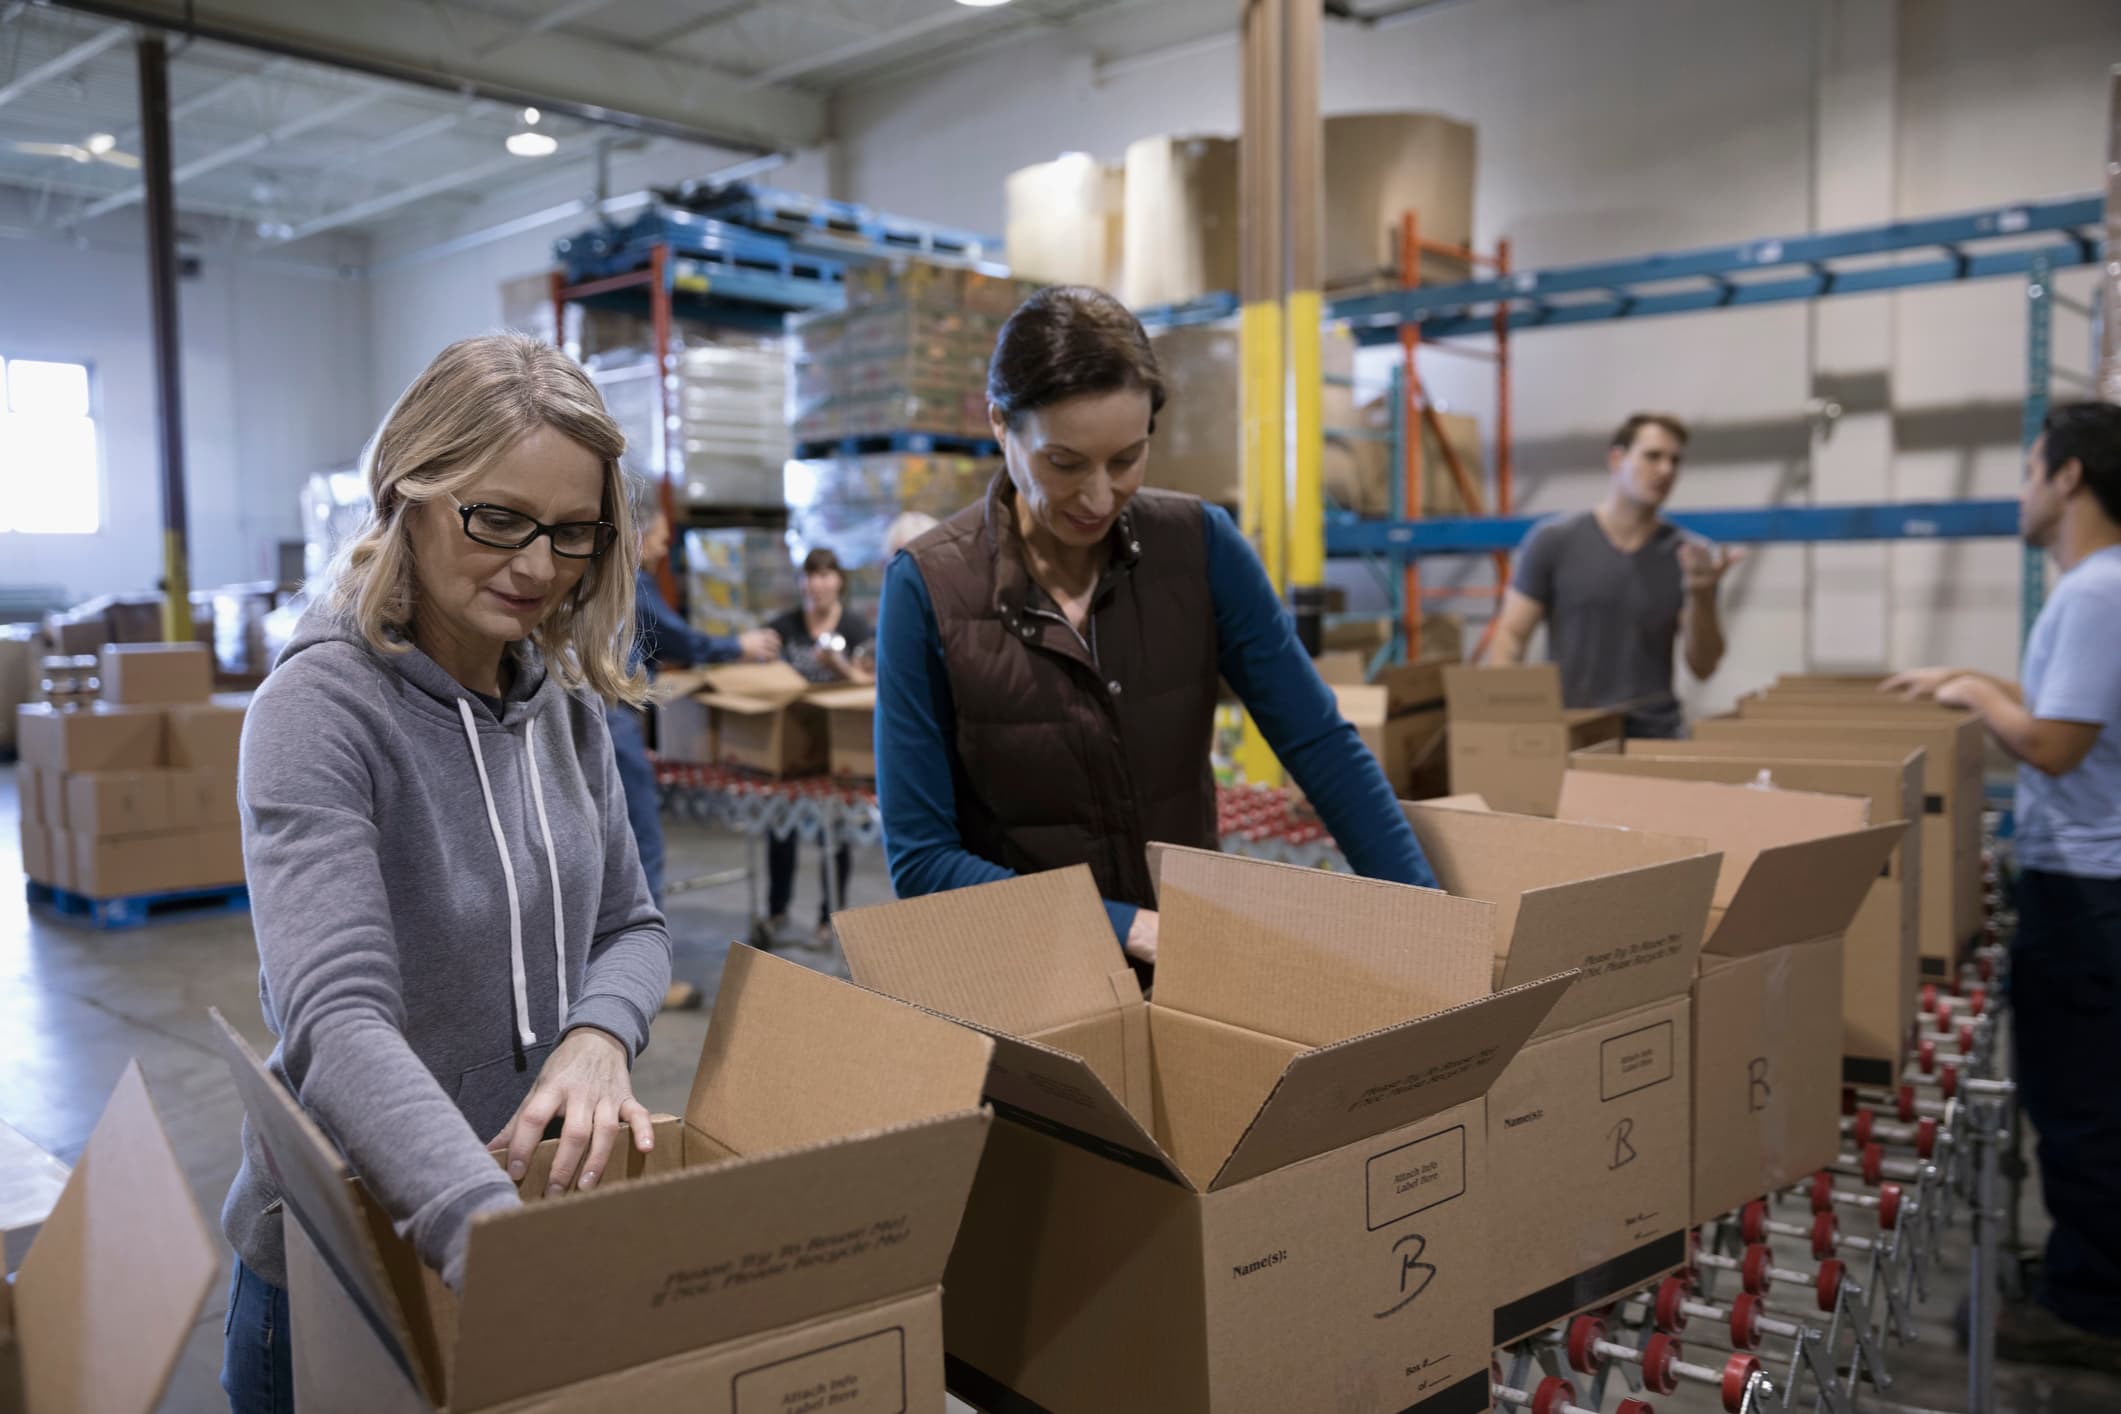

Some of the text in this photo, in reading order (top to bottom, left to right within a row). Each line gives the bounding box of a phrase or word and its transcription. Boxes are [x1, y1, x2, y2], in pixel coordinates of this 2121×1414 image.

[1748, 1056, 1771, 1113] B
[1606, 1117, 1637, 1171] B
[1393, 1160, 1438, 1186] Attach Info
[1395, 1172, 1439, 1194] Label Here
[1232, 1249, 1288, 1280] Name(s):
[1373, 1233, 1437, 1320] B
[1405, 1363, 1421, 1376] Box
[783, 1382, 827, 1405] Attach
[1418, 1379, 1428, 1391] of
